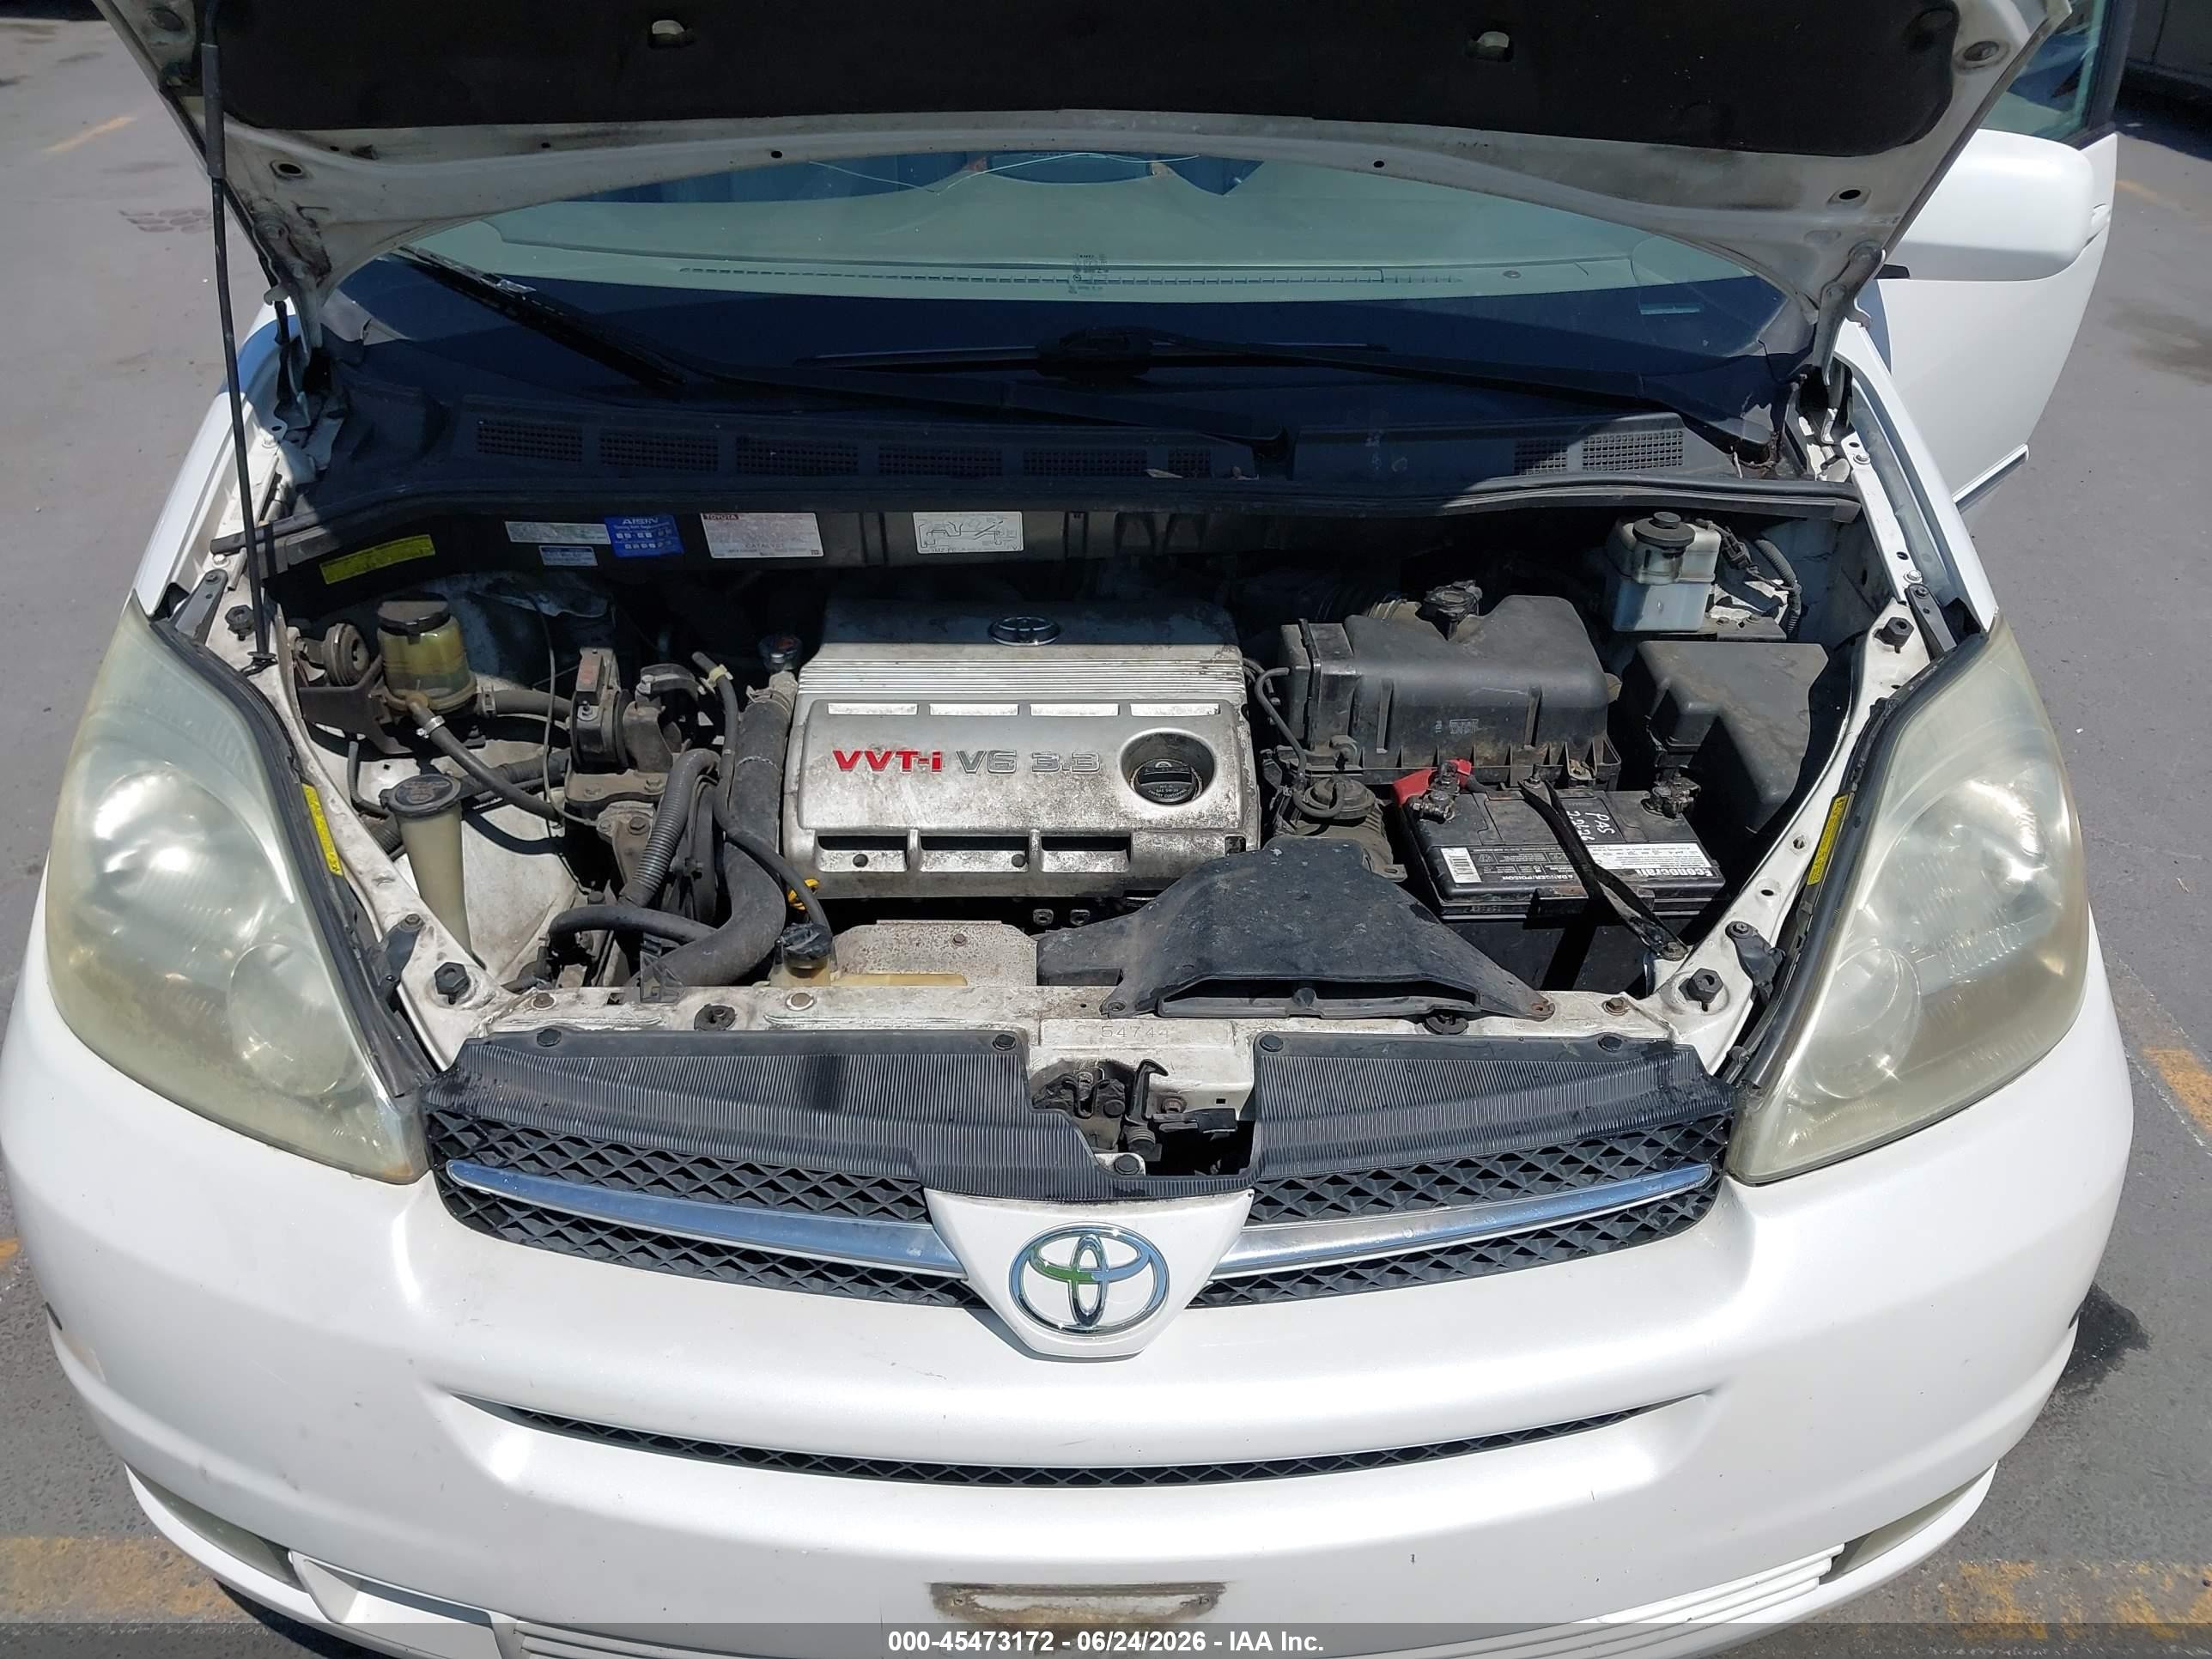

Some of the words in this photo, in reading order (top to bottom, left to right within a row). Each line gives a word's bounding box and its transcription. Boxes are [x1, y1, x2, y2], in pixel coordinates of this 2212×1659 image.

[833, 750, 943, 773] VVT-i
[956, 750, 1018, 775] V6
[1031, 750, 1101, 775] 3.3
